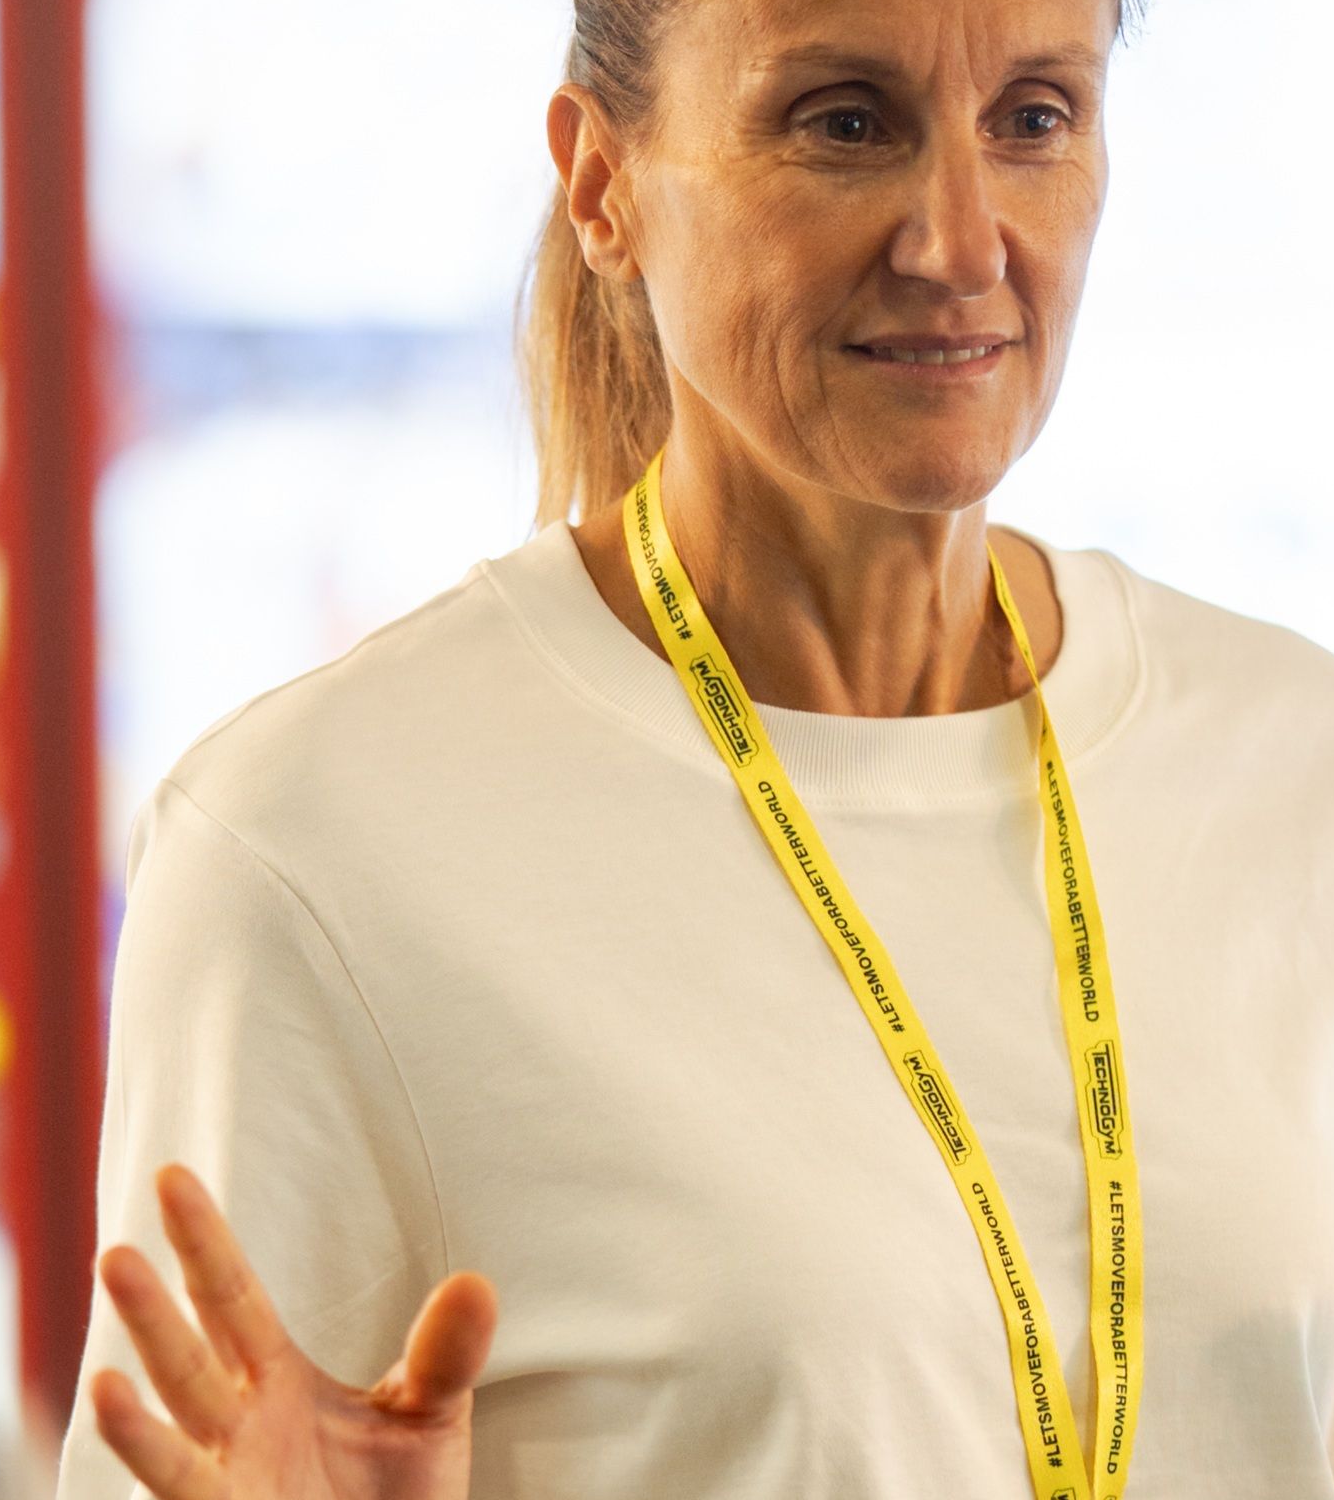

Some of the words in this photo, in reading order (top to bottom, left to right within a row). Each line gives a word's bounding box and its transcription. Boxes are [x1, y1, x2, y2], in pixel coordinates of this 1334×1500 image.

[695, 660, 753, 764] TECHNOGYM
[758, 780, 905, 1033] #LETSMOVEFORABETTERWORLD
[1045, 760, 1099, 1023] #LETSMOVEFORABETTERWORLD
[908, 1055, 967, 1164] TECHNOGYM
[1091, 1043, 1117, 1156] TECHNOGYM
[971, 1181, 1063, 1468] #LETSMOVEFORABETTERWORLD
[1106, 1180, 1128, 1475] #LETSMOVEFORABETTERWORLD
